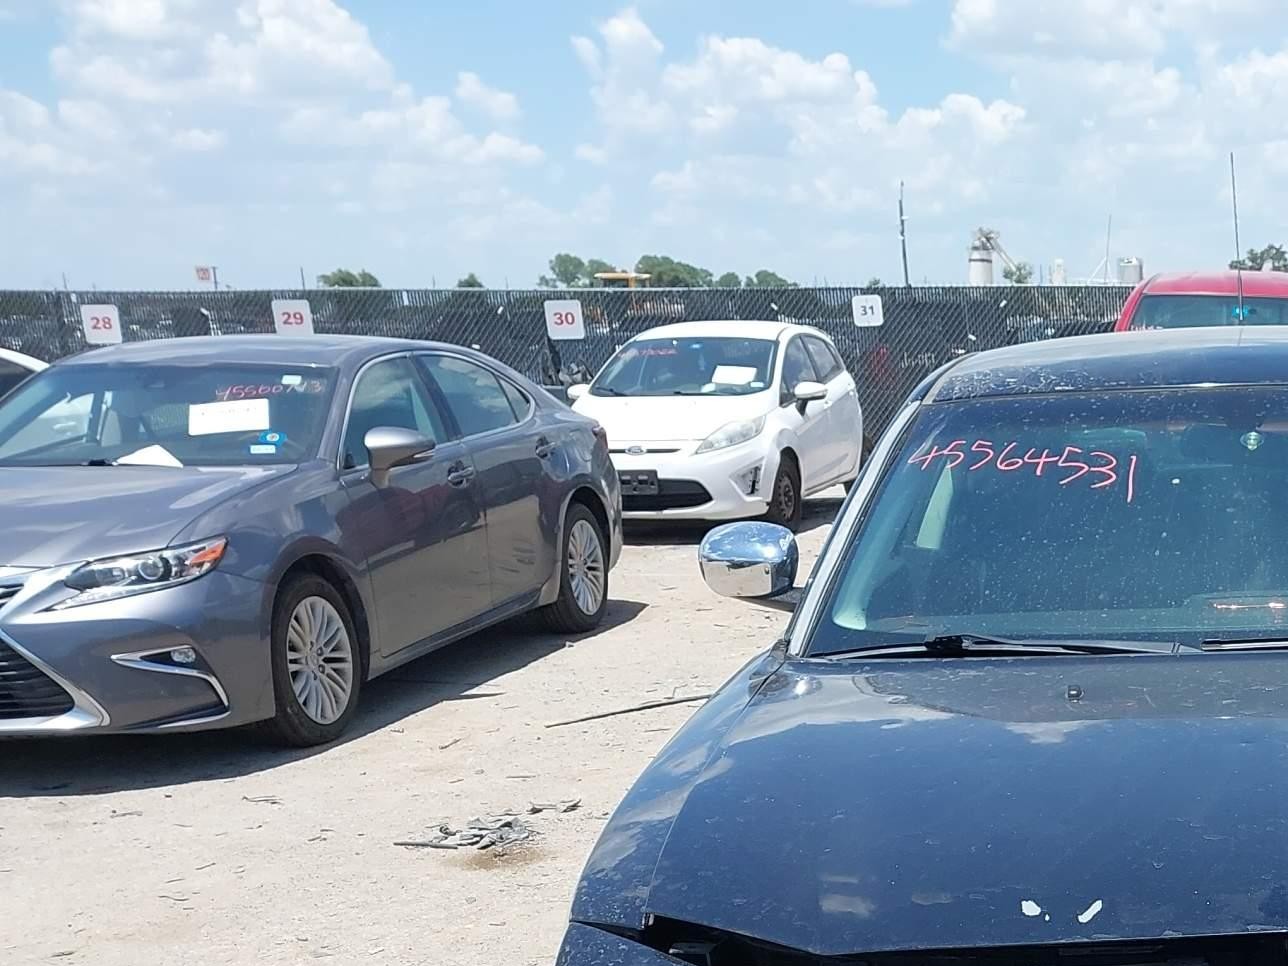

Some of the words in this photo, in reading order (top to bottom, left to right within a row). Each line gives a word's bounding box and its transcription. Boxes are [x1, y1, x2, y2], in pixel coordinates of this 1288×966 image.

[860, 304, 875, 316] 31
[90, 316, 113, 330] 28
[281, 311, 304, 325] 29
[553, 311, 575, 326] 30
[907, 440, 1137, 502] 45564531
